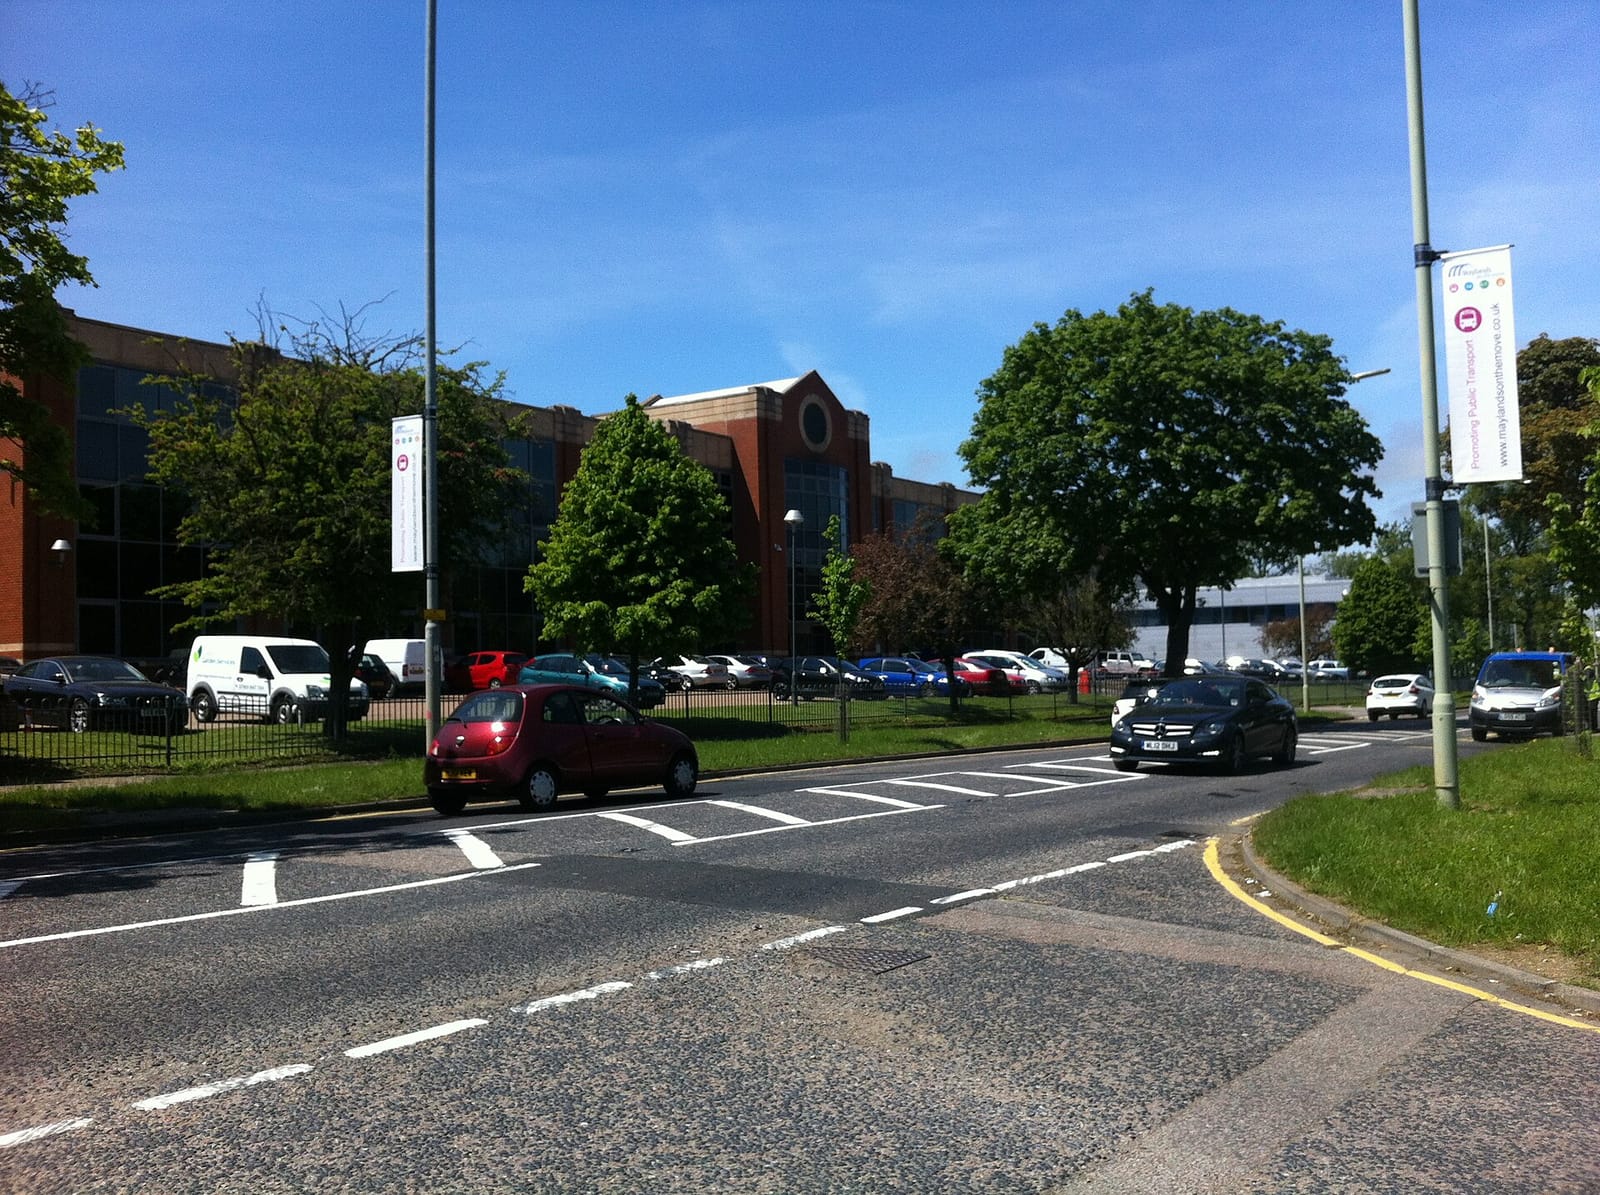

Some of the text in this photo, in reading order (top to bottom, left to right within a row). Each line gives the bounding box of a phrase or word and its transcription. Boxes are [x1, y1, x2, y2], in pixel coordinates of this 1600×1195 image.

[1465, 340, 1480, 469] Promoting Public Transport
[1491, 303, 1508, 467] www.maylandsonthemove.co.uk
